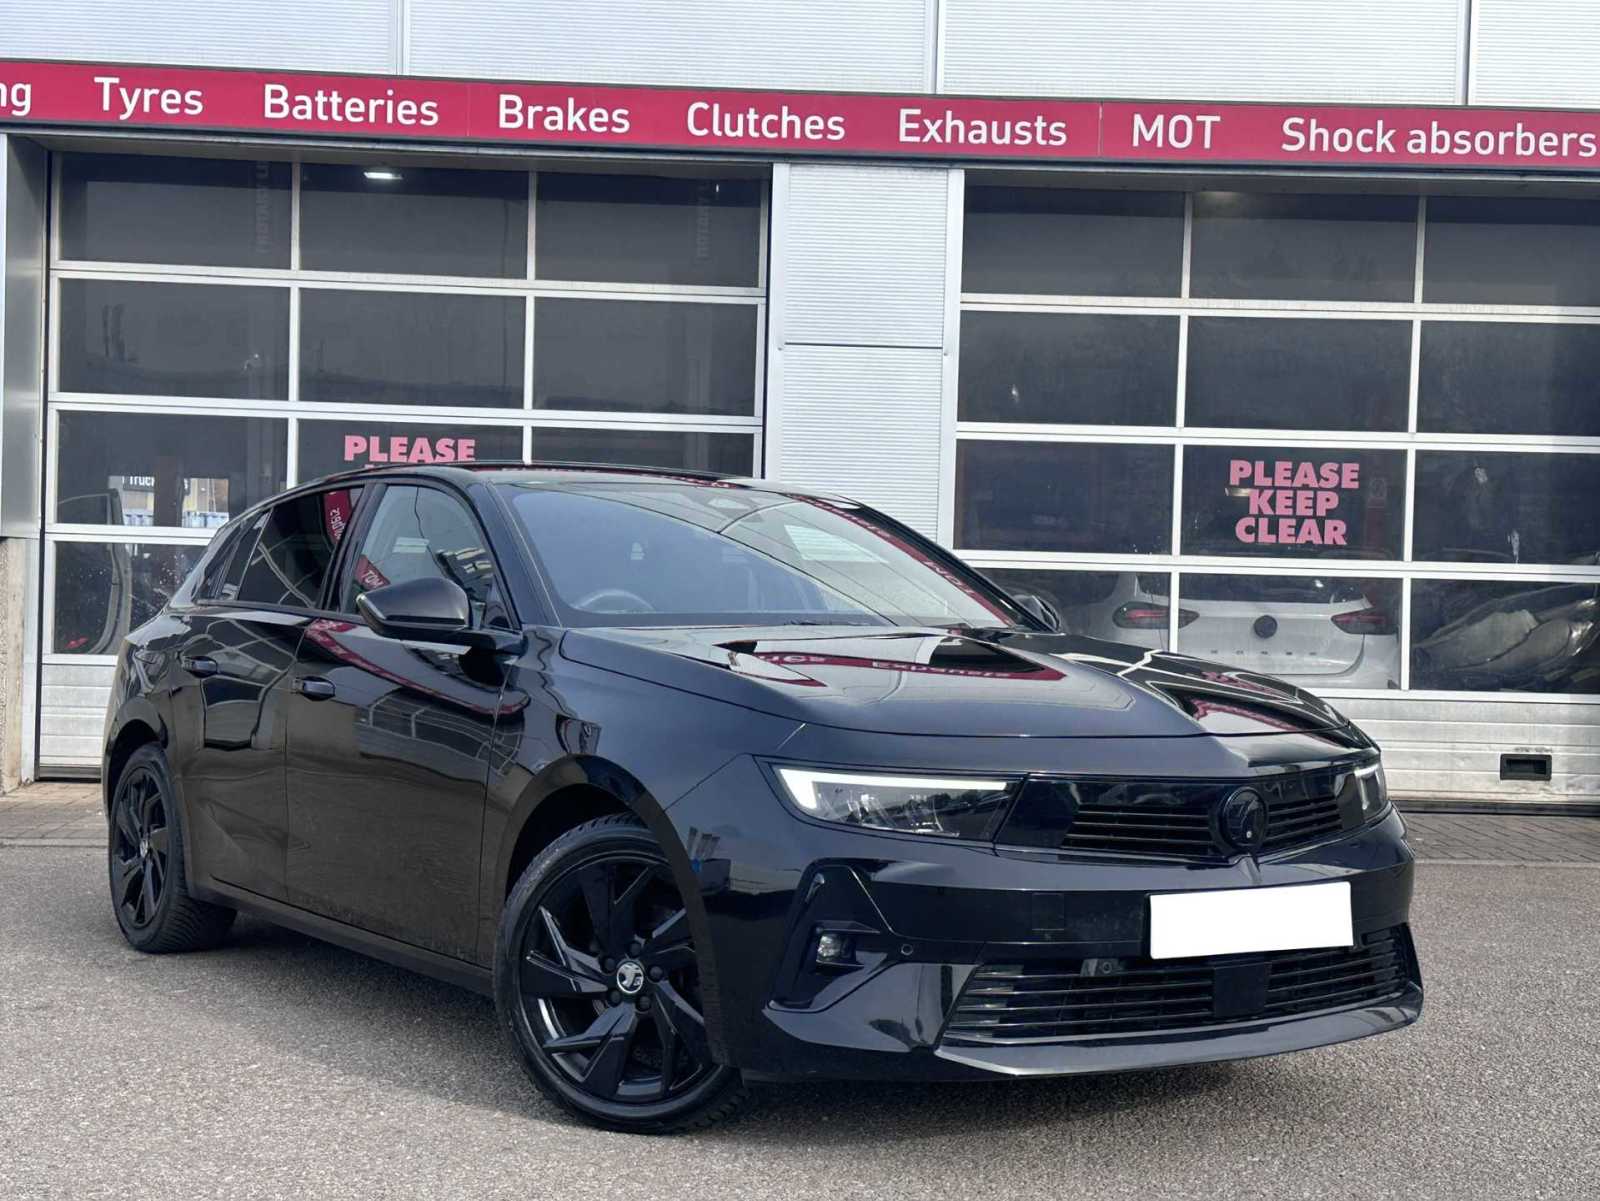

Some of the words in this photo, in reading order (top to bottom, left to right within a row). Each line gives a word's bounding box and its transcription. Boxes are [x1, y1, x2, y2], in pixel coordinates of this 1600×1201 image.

[93, 76, 204, 120] Tyres
[264, 83, 439, 126] Batteries
[499, 93, 630, 134] Brakes
[687, 101, 845, 141] Clutches
[899, 108, 1067, 146] Exhausts
[1132, 113, 1221, 149] MOT
[1281, 116, 1396, 154] Shock
[1406, 120, 1597, 158] absorbers
[344, 435, 476, 464] PLEASE
[1230, 460, 1360, 490] PLEASE
[1248, 489, 1339, 518] KEEP
[1235, 516, 1347, 545] CLEAR
